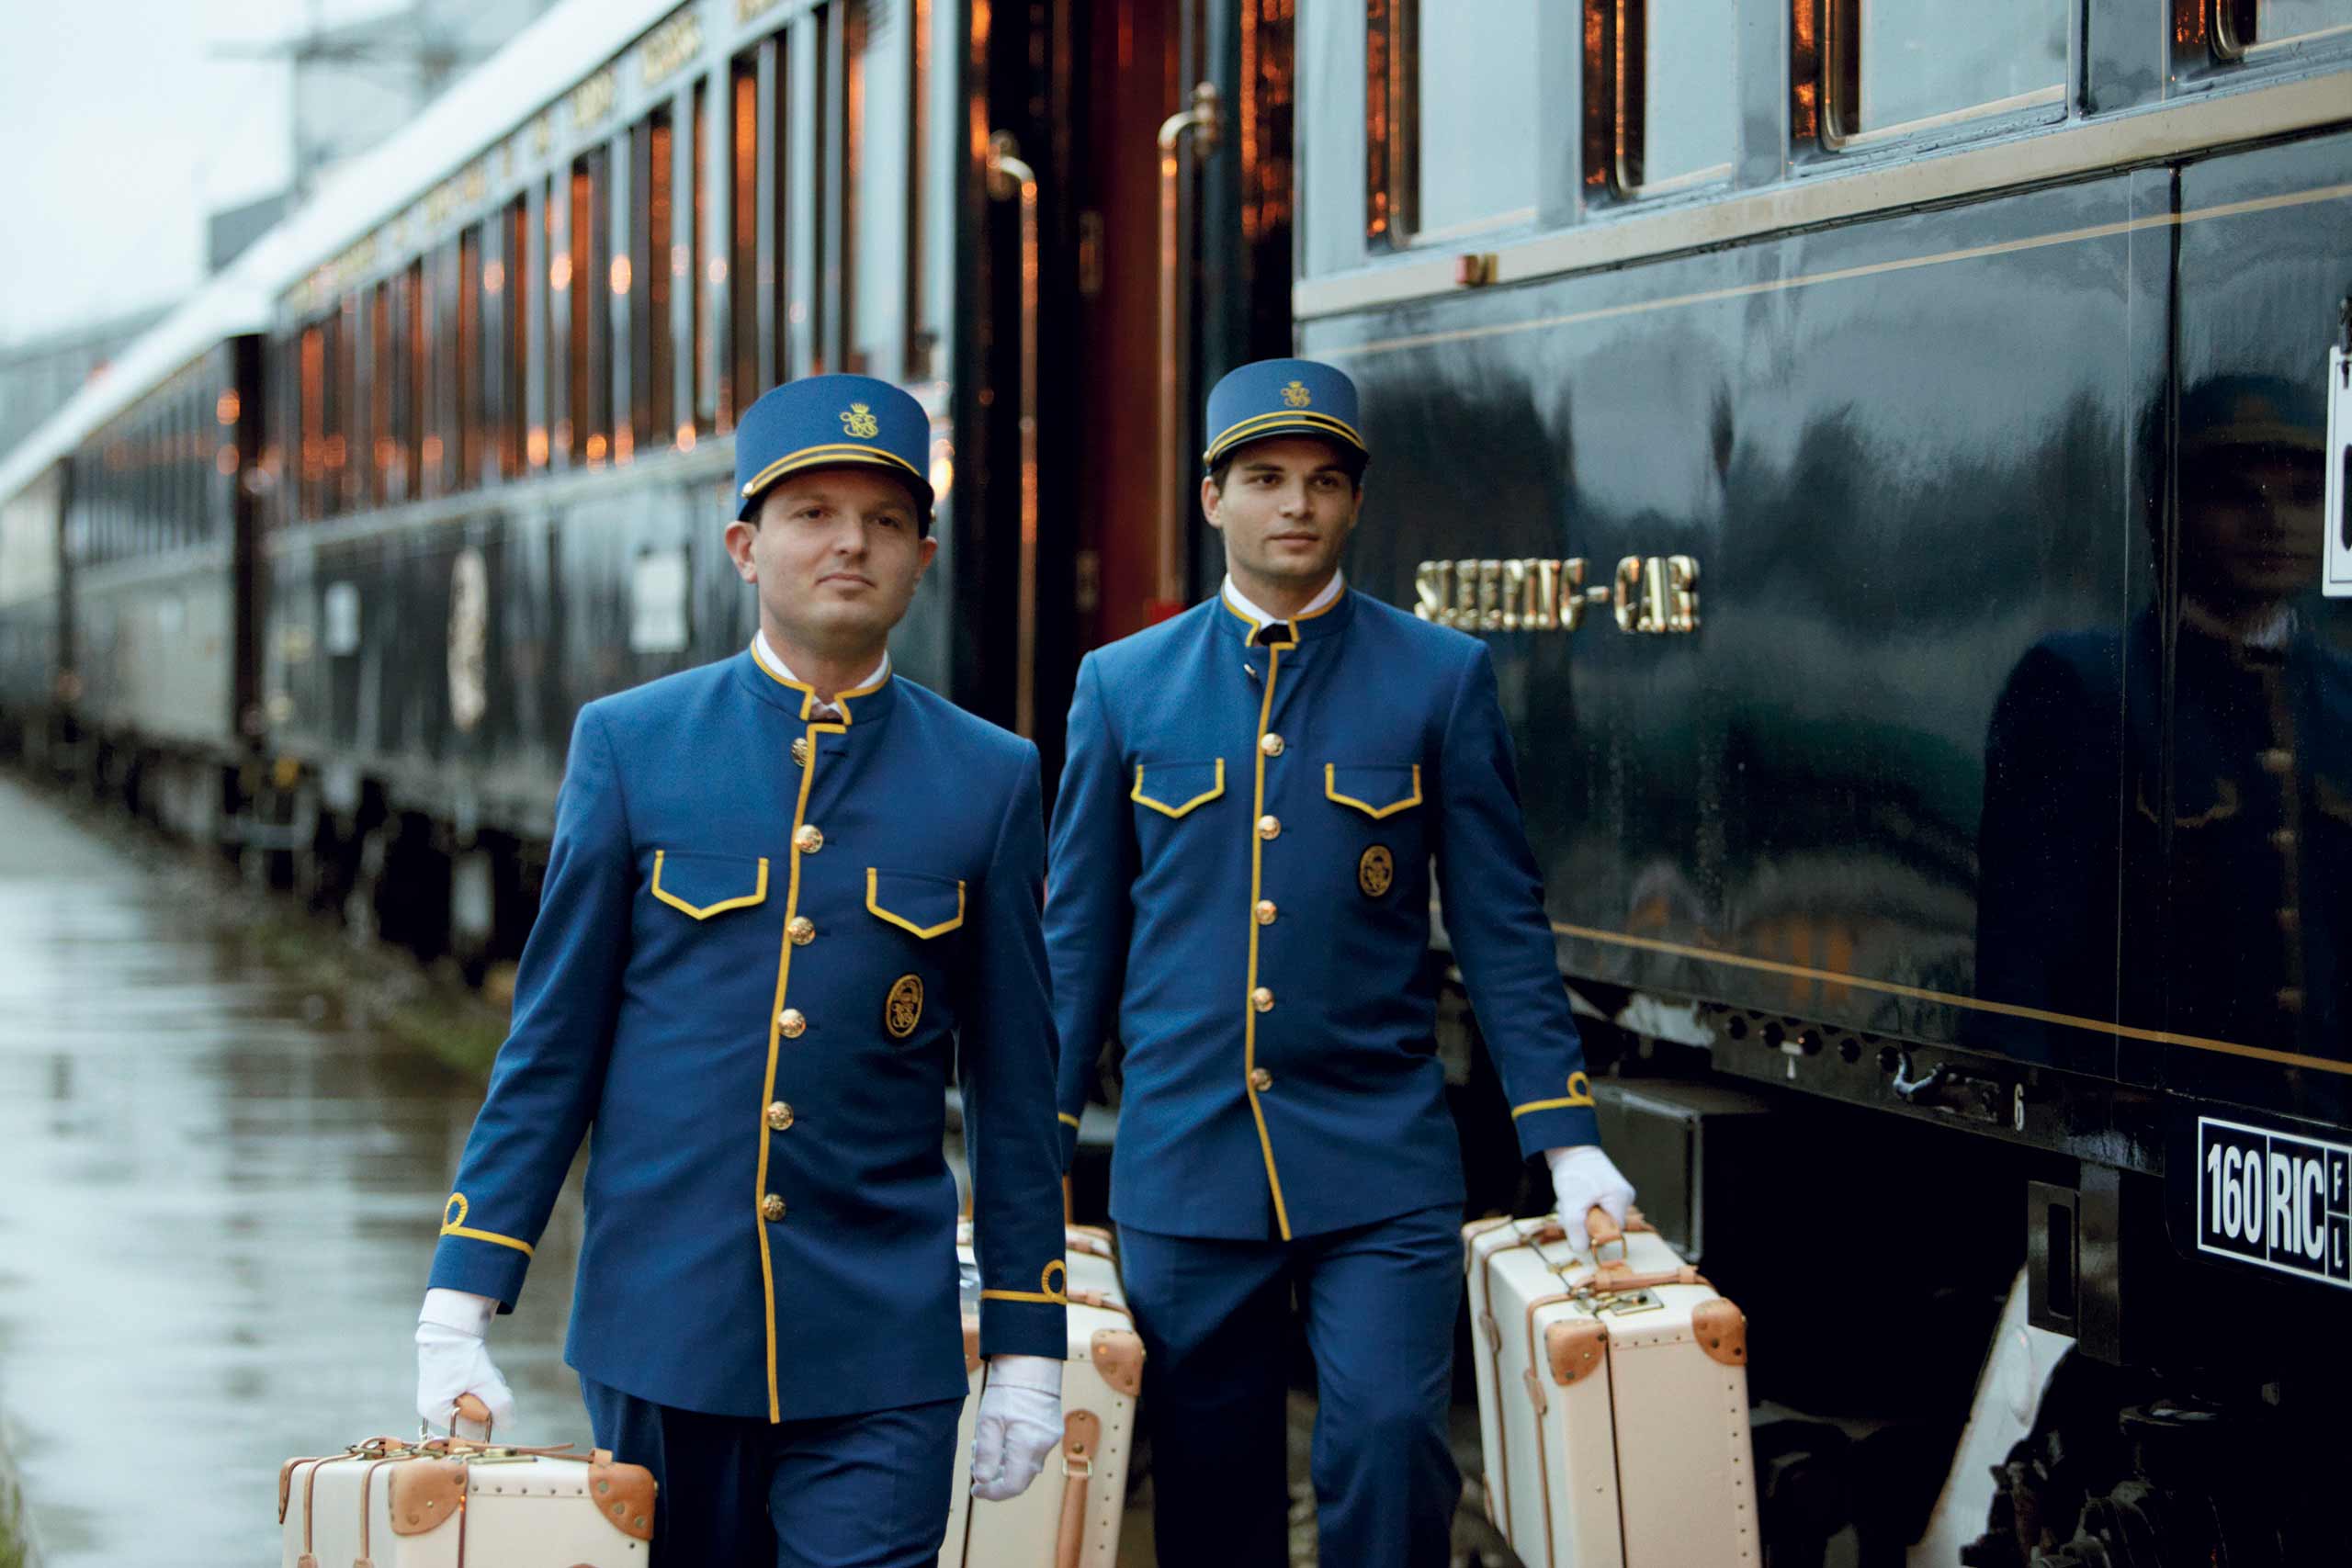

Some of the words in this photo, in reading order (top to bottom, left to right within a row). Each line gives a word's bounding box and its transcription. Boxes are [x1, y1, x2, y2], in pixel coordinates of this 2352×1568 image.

[2013, 1082, 2026, 1133] 6
[2207, 1144, 2263, 1244] 160
[2269, 1152, 2324, 1260] RIC
